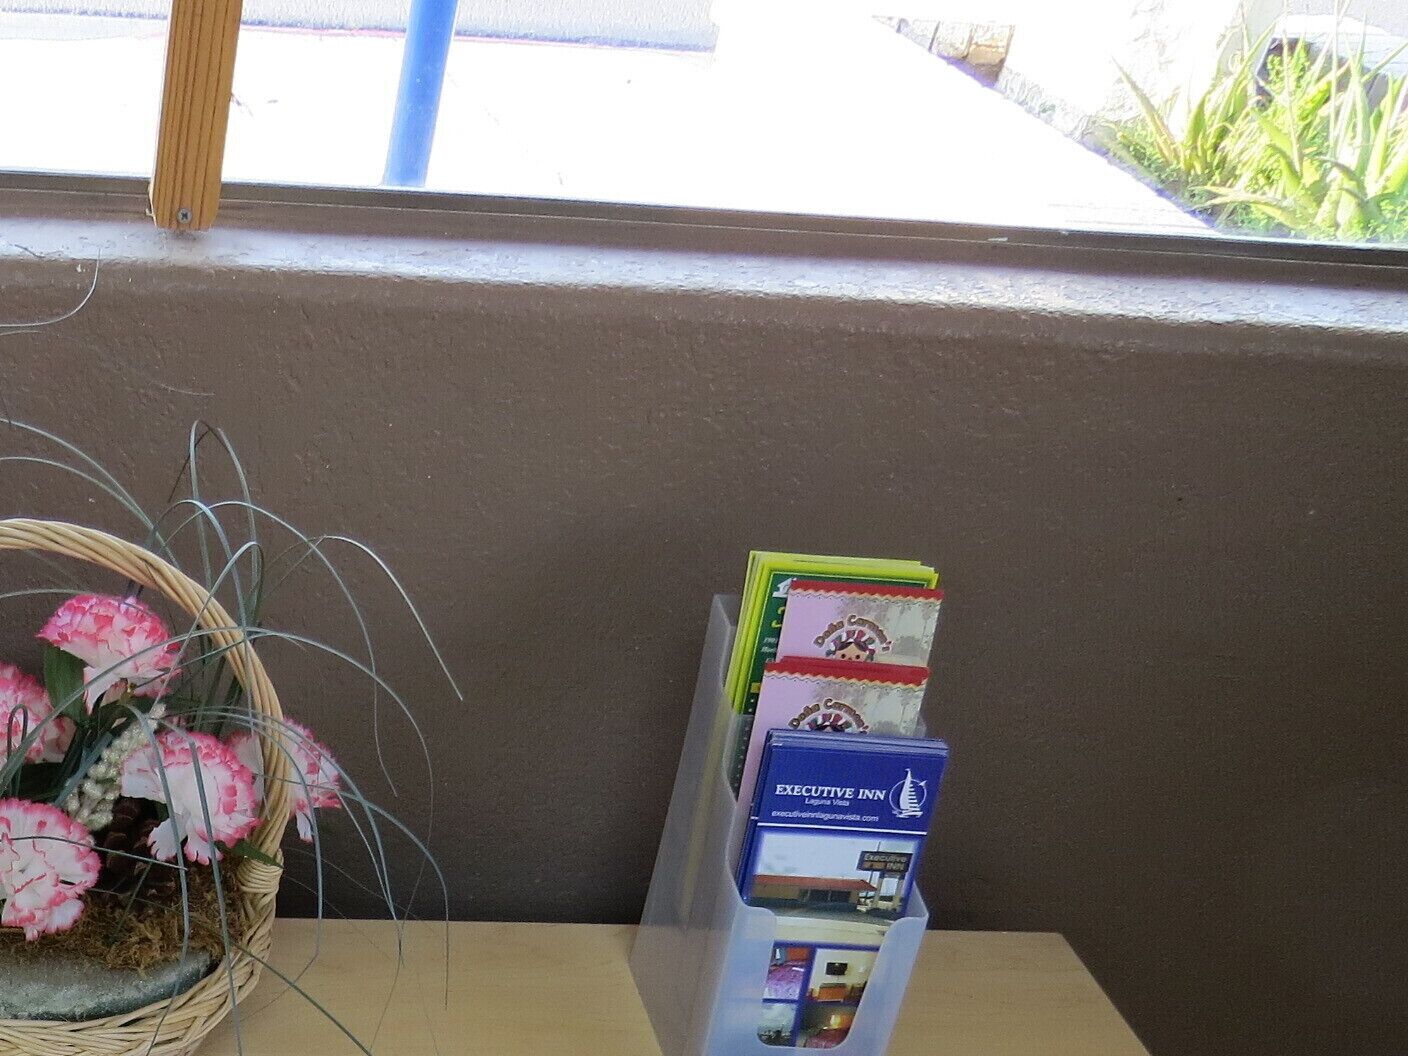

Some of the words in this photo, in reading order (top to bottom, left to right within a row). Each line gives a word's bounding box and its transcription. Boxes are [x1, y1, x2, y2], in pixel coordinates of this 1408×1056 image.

[775, 784, 855, 799] EXECUTIVE
[858, 789, 886, 801] INN
[805, 797, 831, 807] Laguna
[832, 798, 850, 807] Vista
[771, 810, 880, 822] executiveinnlagunavista.com
